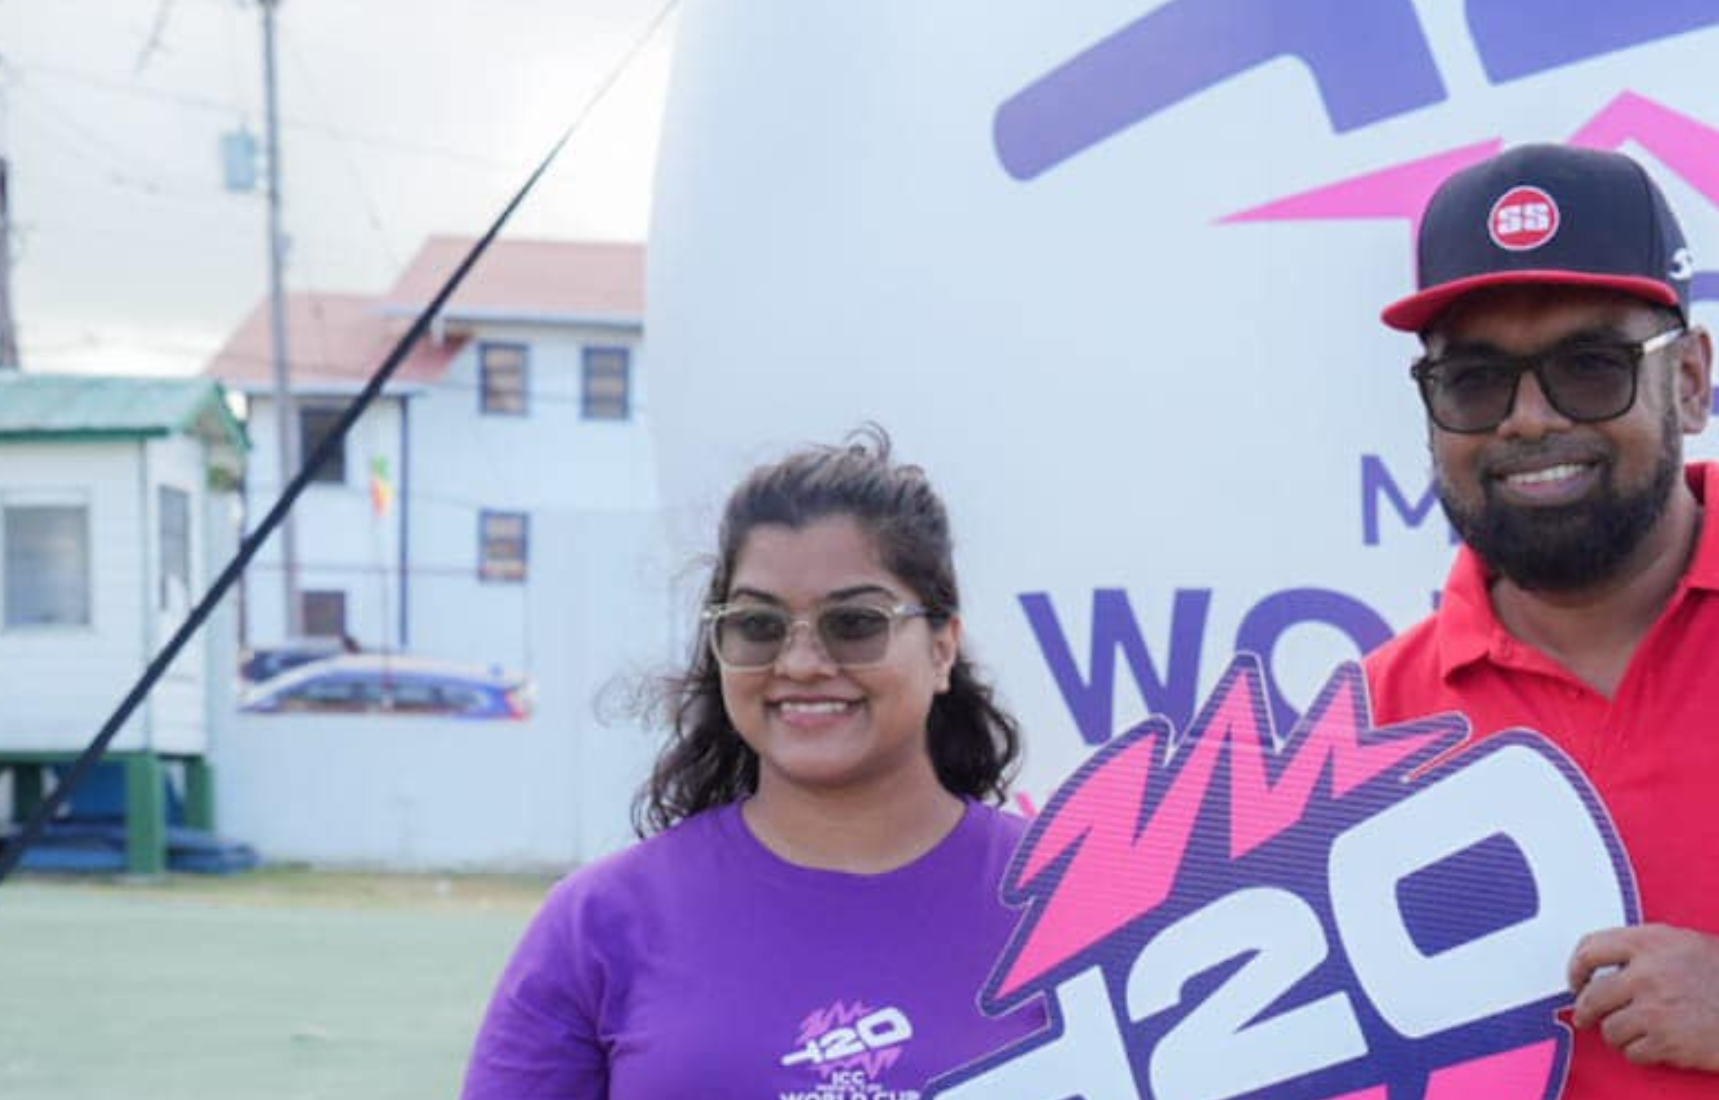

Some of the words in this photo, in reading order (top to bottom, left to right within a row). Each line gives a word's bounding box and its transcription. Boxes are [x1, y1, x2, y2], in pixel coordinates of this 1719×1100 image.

[1497, 202, 1550, 236] SS
[780, 1005, 914, 1067] T20
[831, 1071, 867, 1087] ICC
